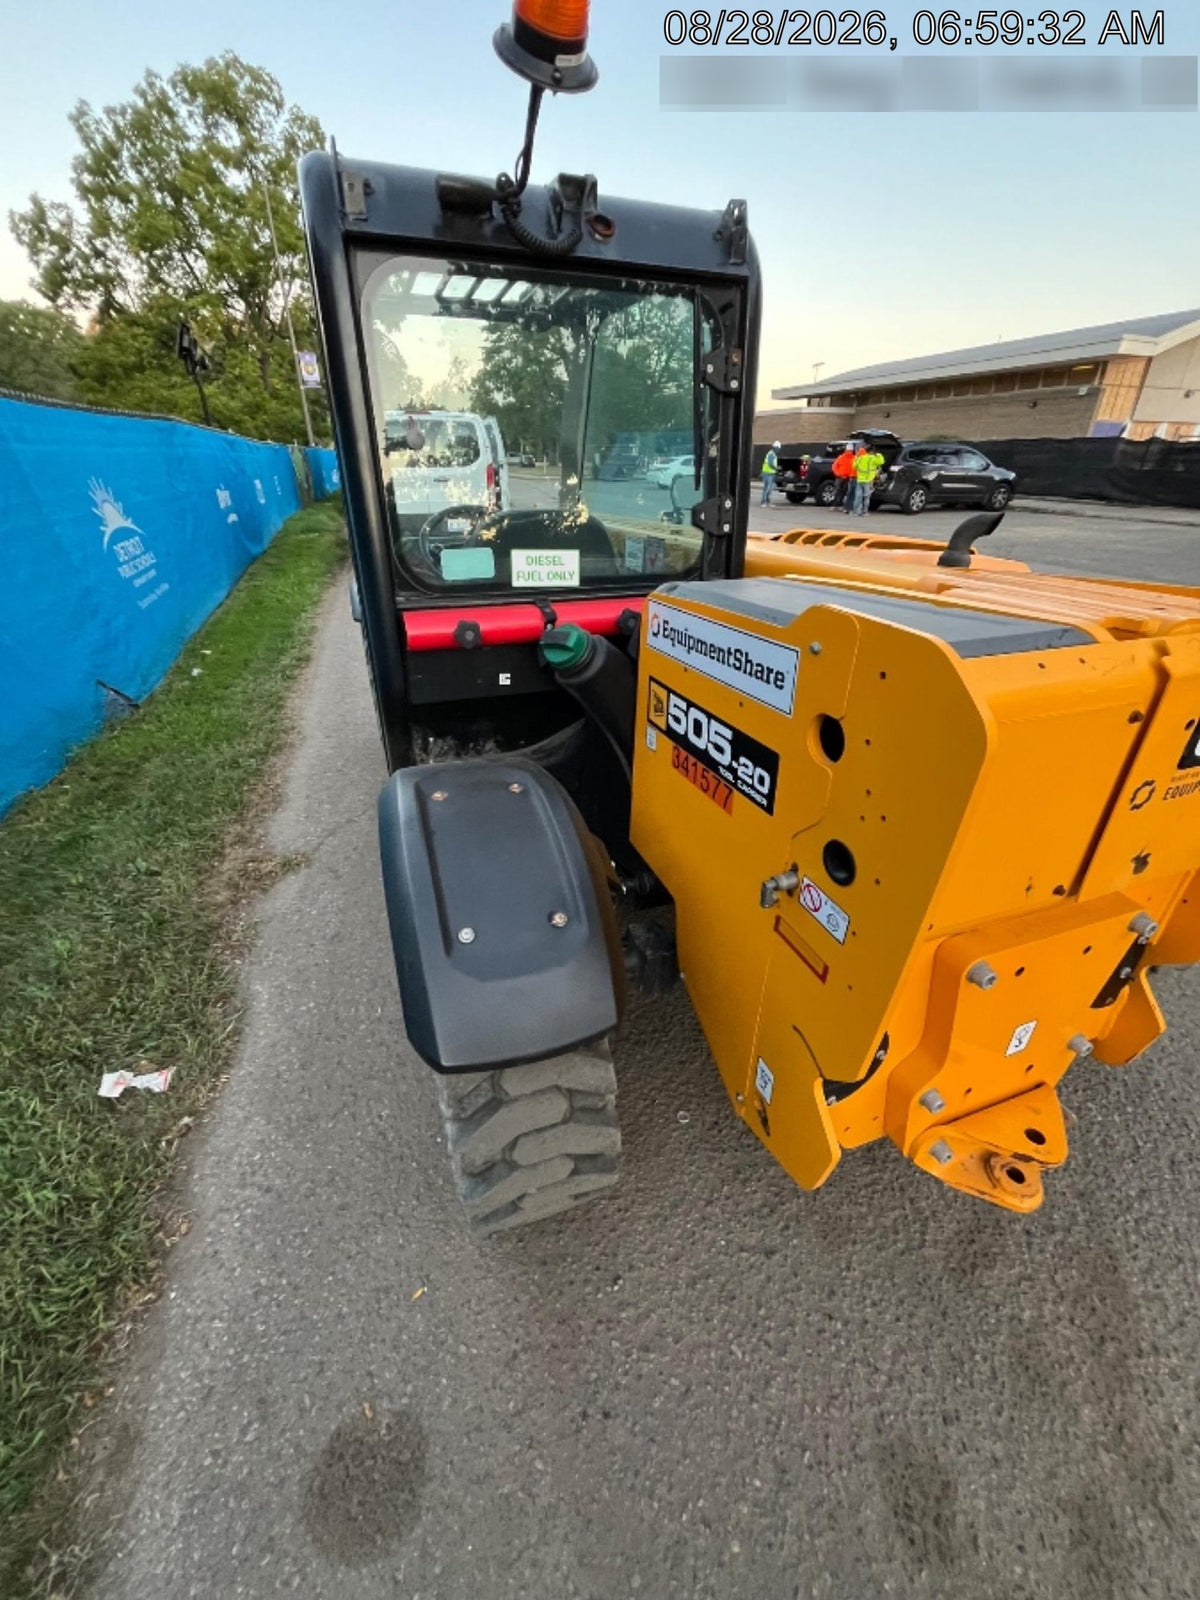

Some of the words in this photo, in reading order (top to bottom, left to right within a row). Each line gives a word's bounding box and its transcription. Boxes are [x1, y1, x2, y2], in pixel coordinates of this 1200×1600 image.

[516, 570, 544, 582] FUEL
[546, 570, 575, 582] ONLY
[525, 555, 565, 566] DIESEL
[661, 618, 787, 691] EquipmentShare
[671, 745, 734, 811] 341577
